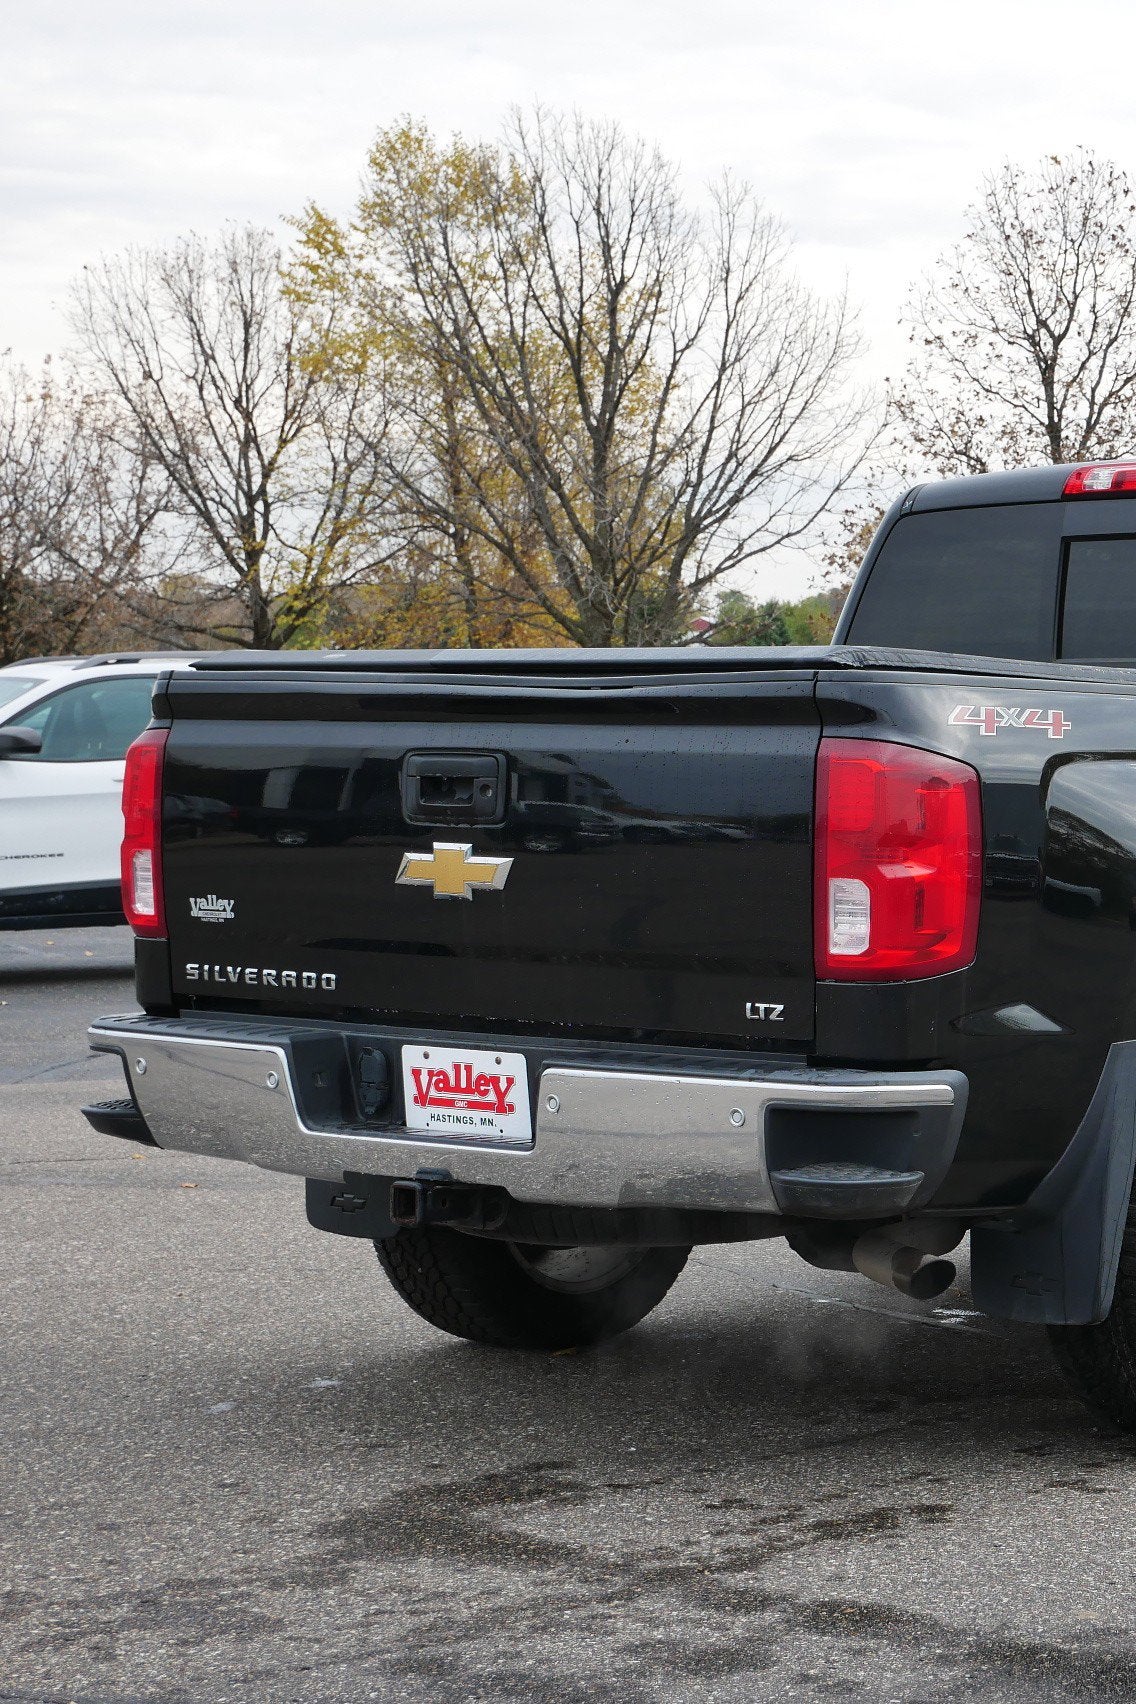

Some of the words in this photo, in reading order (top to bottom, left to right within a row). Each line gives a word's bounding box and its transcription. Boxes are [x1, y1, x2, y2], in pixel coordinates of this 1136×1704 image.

[185, 963, 336, 990] SILVERADO
[746, 1002, 784, 1020] LTZ
[411, 1062, 516, 1115] Valley
[430, 1113, 477, 1127] HASTINGS,
